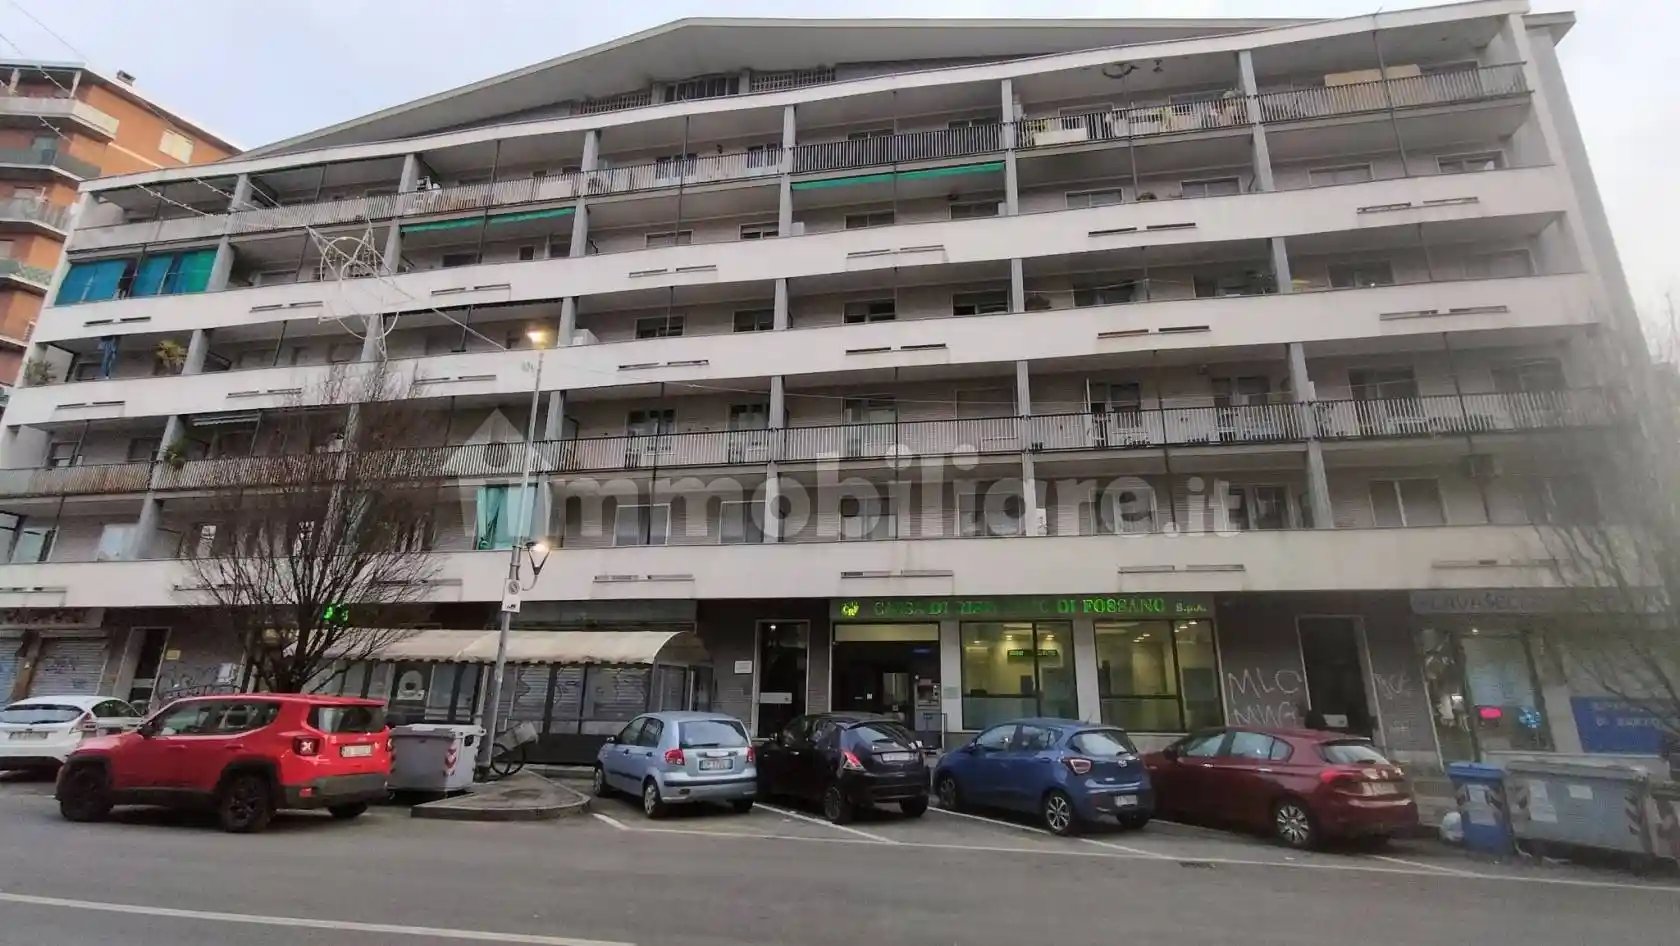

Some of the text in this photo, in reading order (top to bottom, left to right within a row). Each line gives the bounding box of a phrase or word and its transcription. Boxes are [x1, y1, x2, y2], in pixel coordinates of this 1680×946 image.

[1057, 599, 1076, 614] DI
[1082, 598, 1165, 614] FOSSANO
[1227, 667, 1303, 704] MLC
